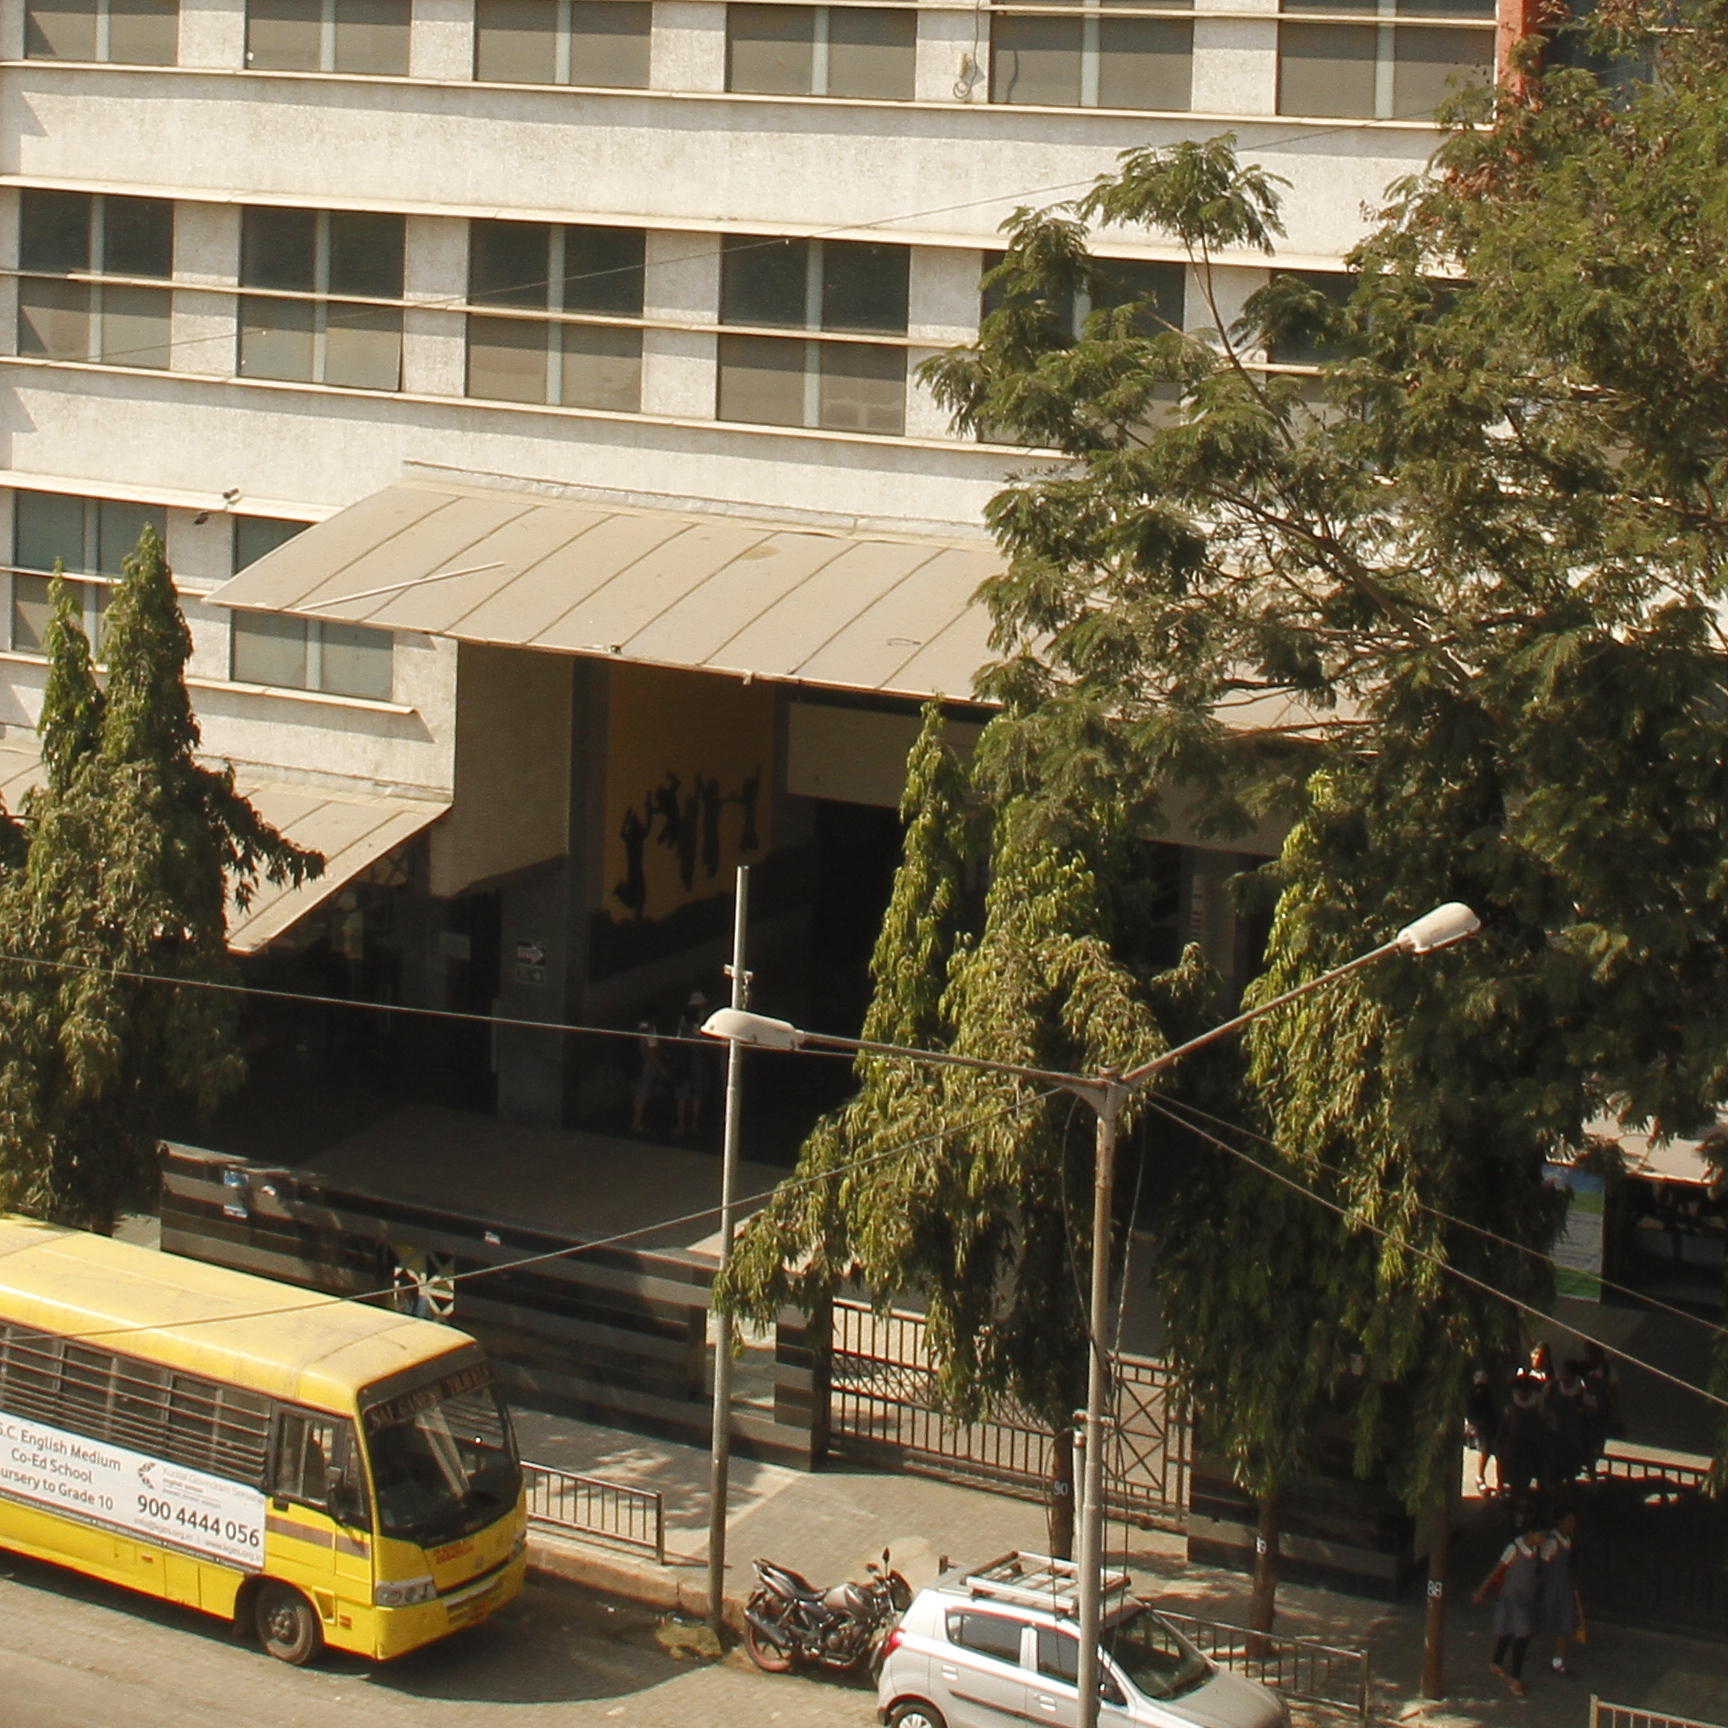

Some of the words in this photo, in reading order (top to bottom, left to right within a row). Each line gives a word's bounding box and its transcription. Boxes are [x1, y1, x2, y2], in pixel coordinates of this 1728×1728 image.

[11, 1447, 48, 1470] Co-Ed
[49, 1458, 93, 1484] School
[20, 1429, 68, 1455] English
[69, 1443, 121, 1471] Medium
[42, 1478, 56, 1493] to
[58, 1482, 96, 1505] Grade
[98, 1493, 114, 1511] 10
[1053, 1480, 1069, 1496] 90
[137, 1493, 171, 1521] 900
[175, 1506, 221, 1536] 4444
[225, 1520, 260, 1547] 056
[1426, 1579, 1443, 1598] 88
